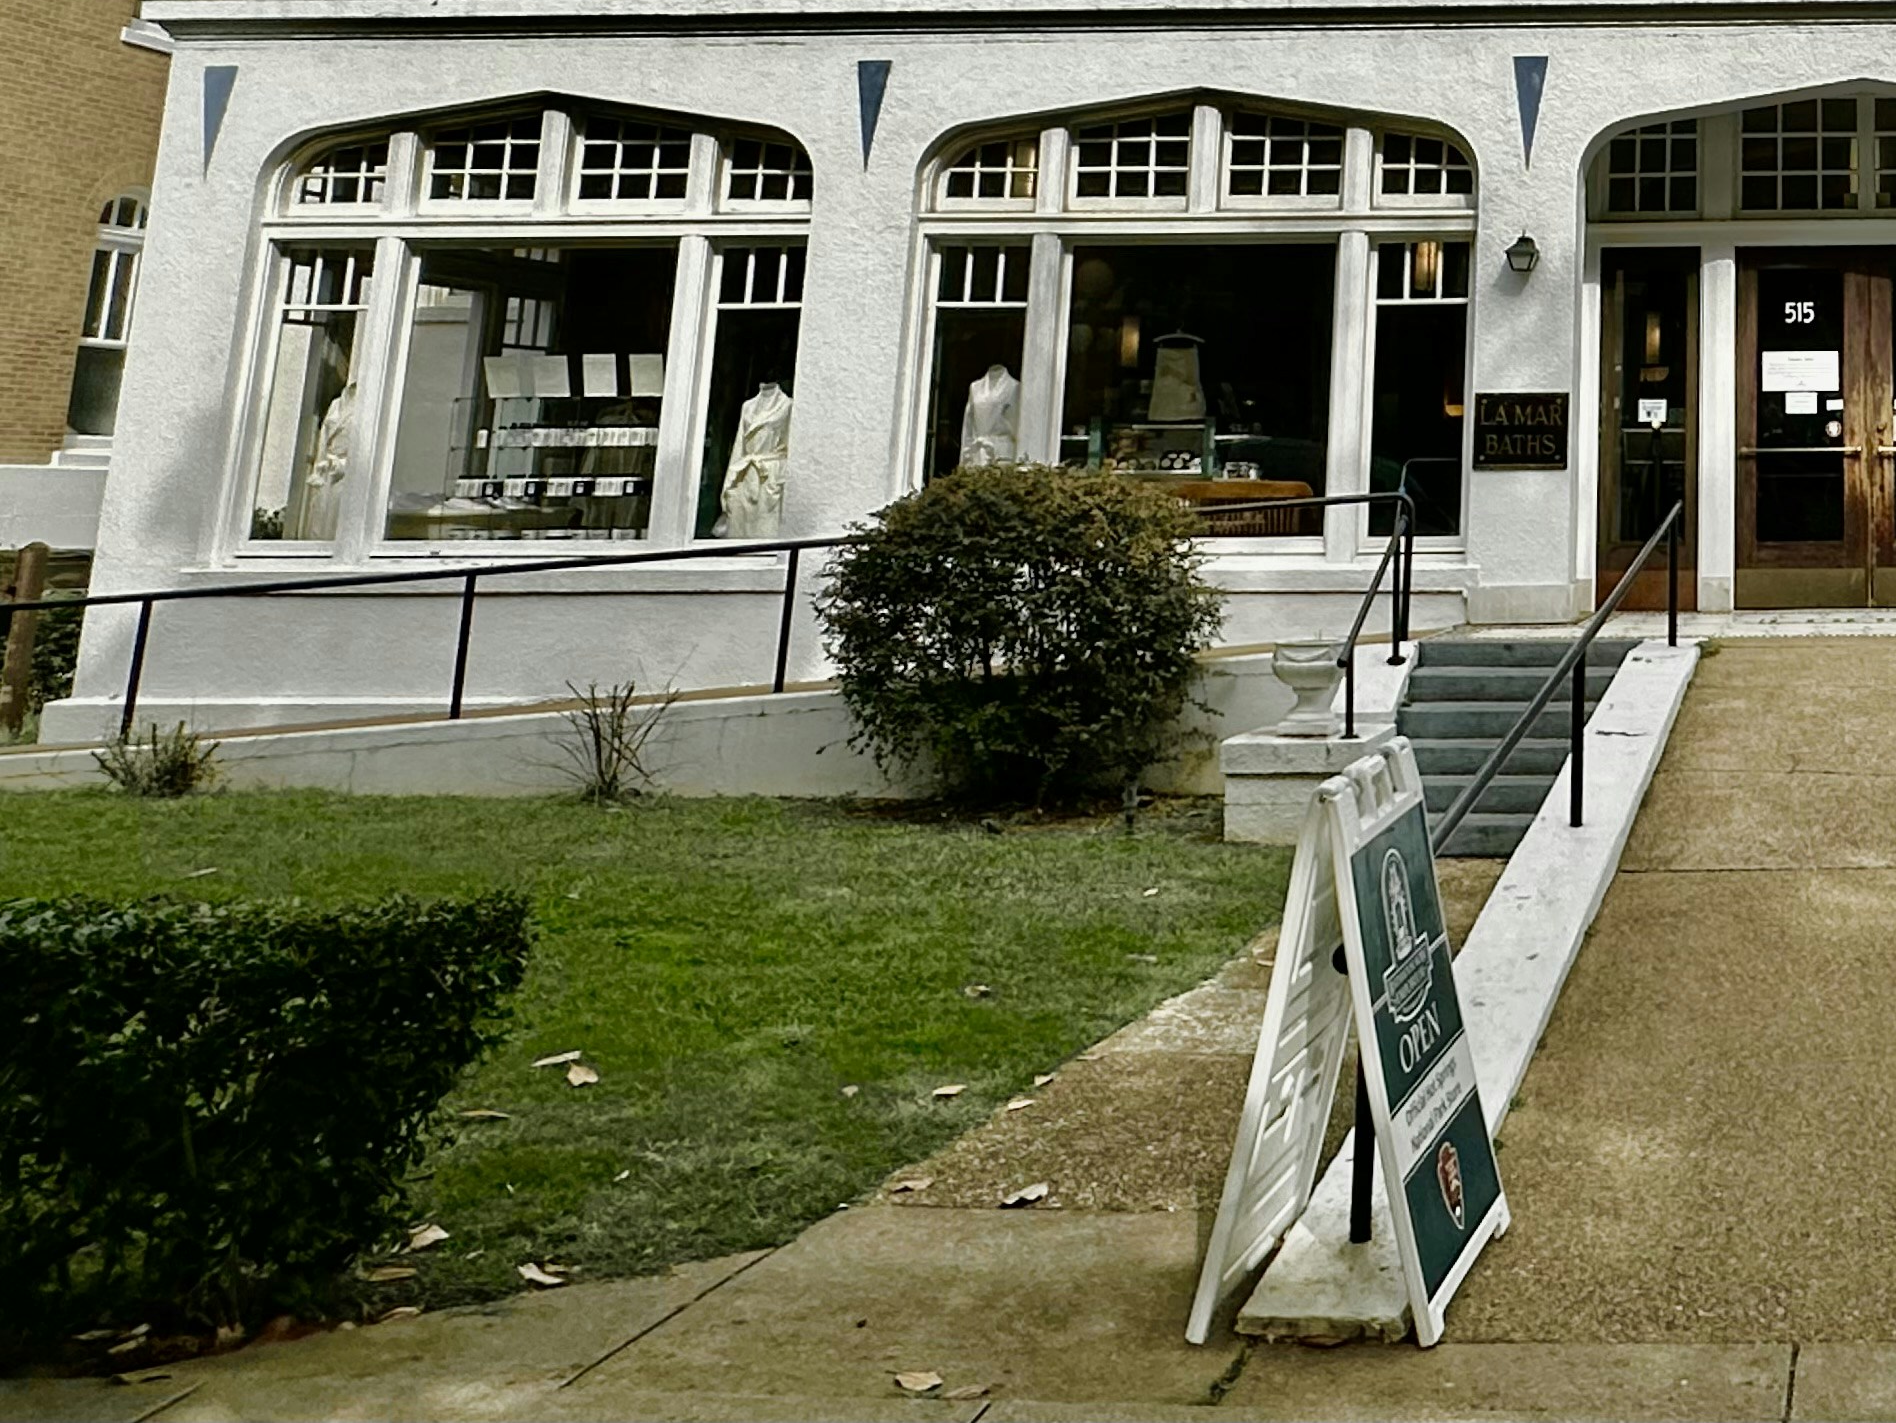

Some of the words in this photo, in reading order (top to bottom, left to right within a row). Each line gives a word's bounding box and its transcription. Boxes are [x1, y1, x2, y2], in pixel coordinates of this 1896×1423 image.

[1785, 301, 1815, 324] 515
[1485, 434, 1556, 455] BATHS
[1399, 1000, 1441, 1074] OPEN
